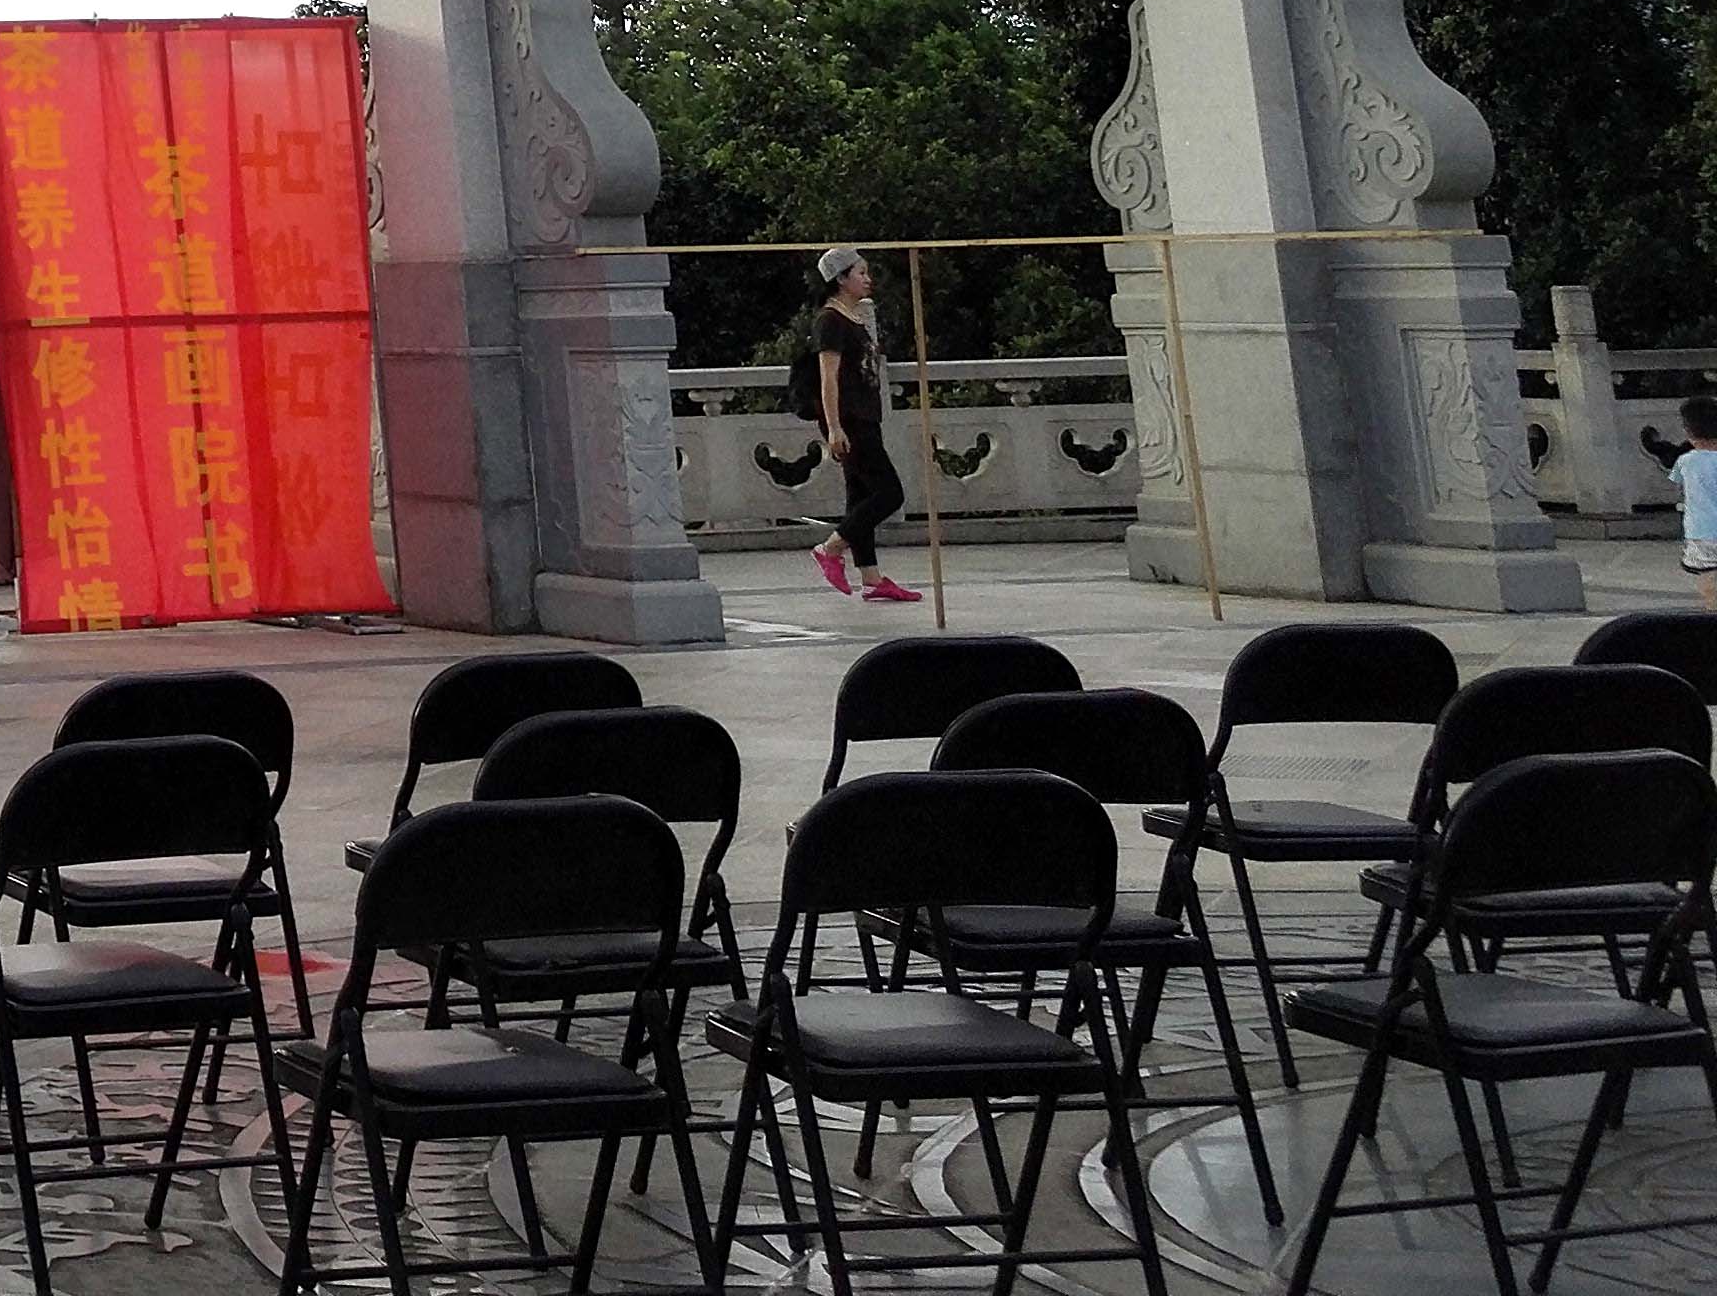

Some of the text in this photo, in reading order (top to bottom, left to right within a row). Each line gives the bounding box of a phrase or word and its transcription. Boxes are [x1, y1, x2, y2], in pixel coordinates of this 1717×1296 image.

[0, 26, 123, 632] 茶道养生修性怡情
